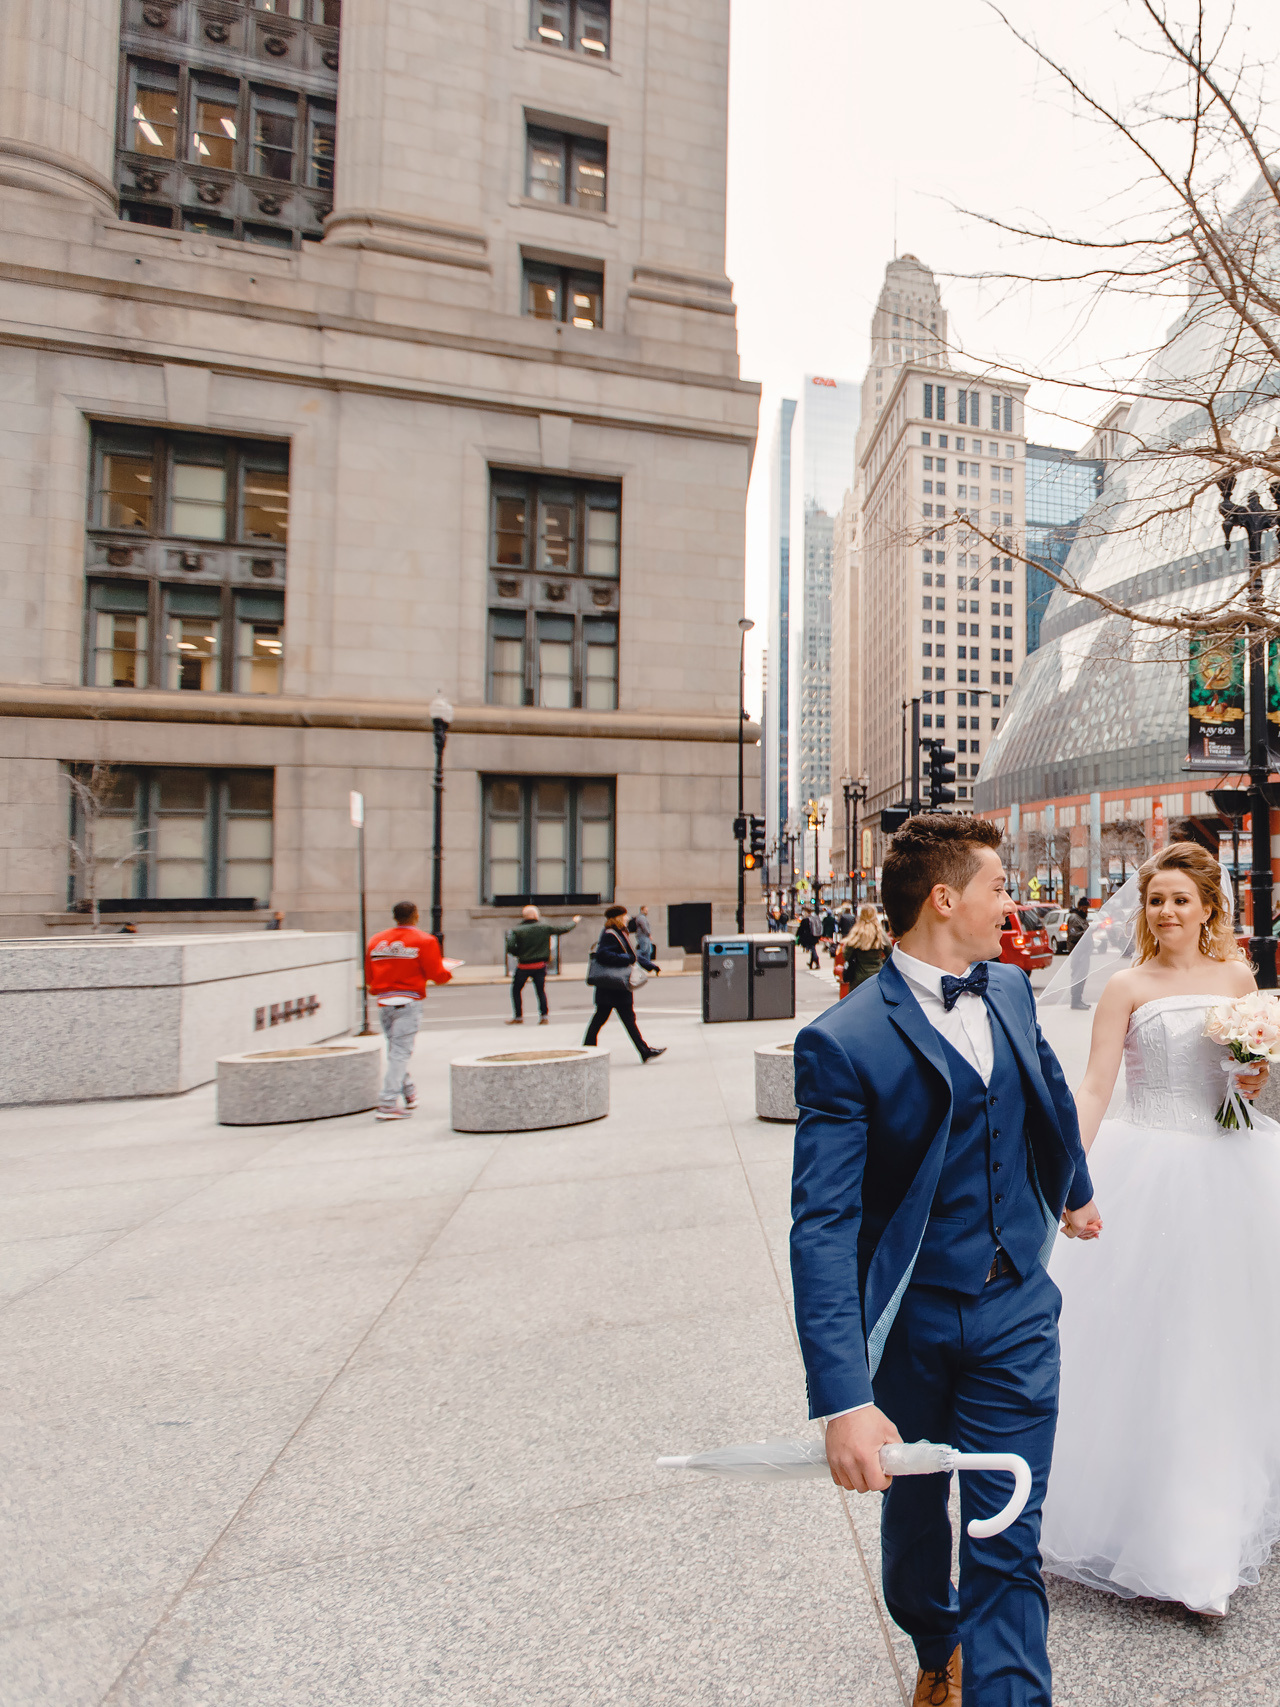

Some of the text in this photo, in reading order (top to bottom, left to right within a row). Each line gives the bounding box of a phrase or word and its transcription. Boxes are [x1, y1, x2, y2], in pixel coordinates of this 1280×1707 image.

[812, 376, 837, 388] CNA
[1199, 726, 1236, 737] MAY 8-20
